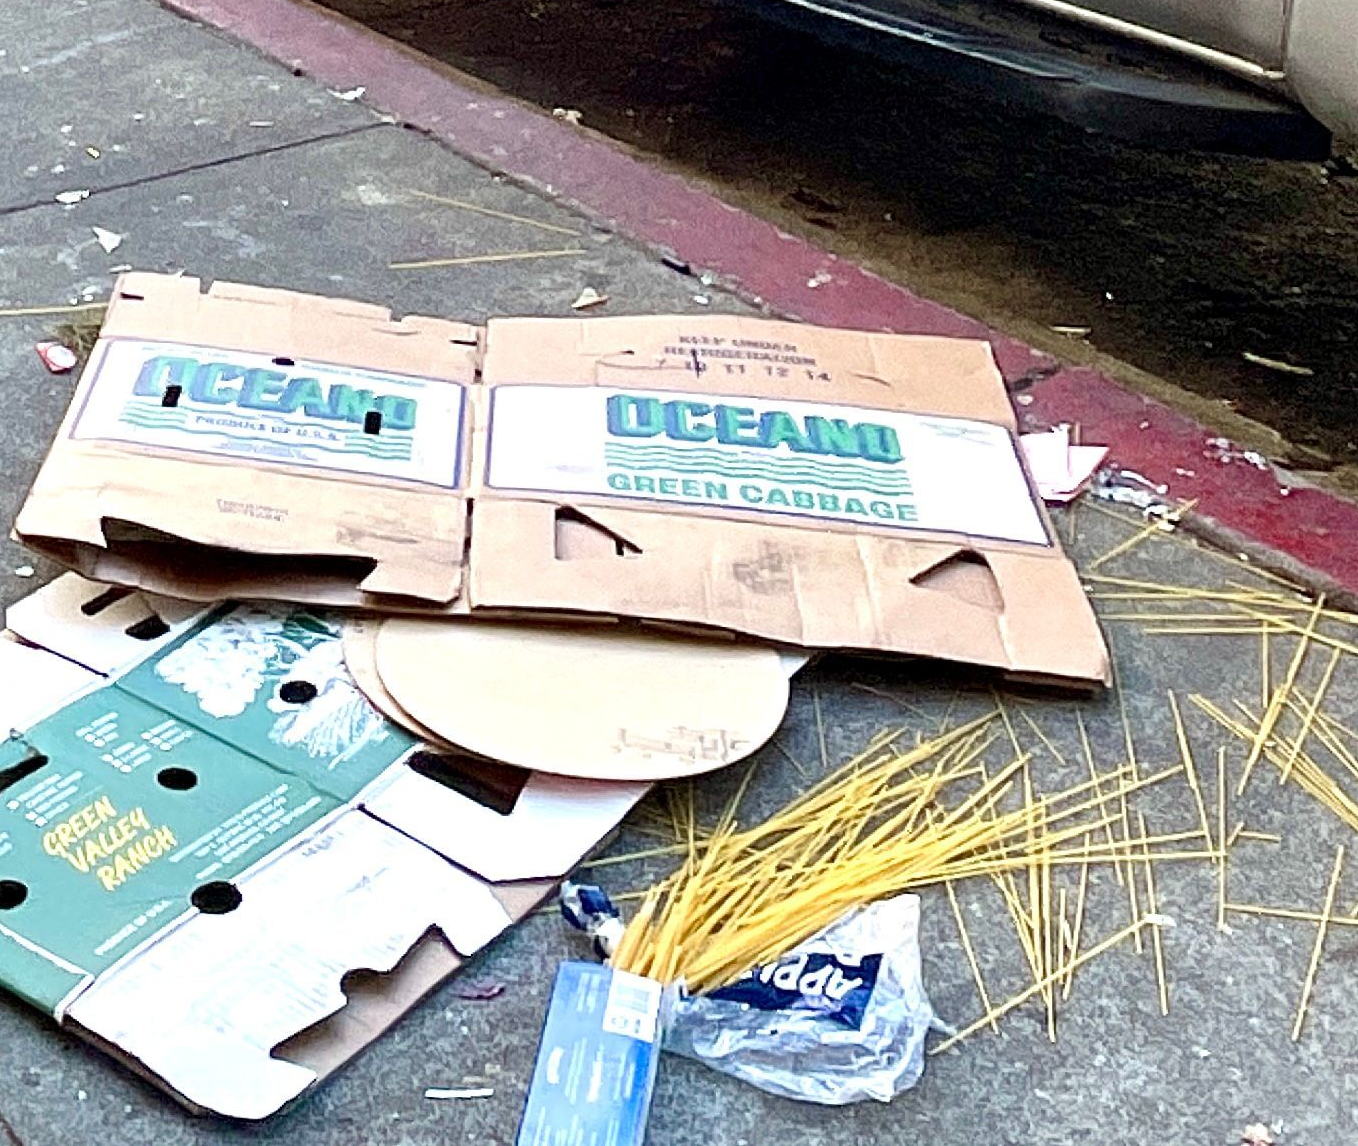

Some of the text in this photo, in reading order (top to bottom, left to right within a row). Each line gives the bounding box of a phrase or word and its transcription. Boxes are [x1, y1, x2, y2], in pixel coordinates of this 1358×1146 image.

[131, 354, 419, 432] OCEANO
[605, 392, 907, 465] OCEANO
[606, 471, 921, 523] GREEN CABBAGE
[41, 796, 118, 859] GREEN
[65, 806, 149, 876] VALLEY
[96, 823, 180, 893] RANCH
[739, 953, 863, 1001] APPL
